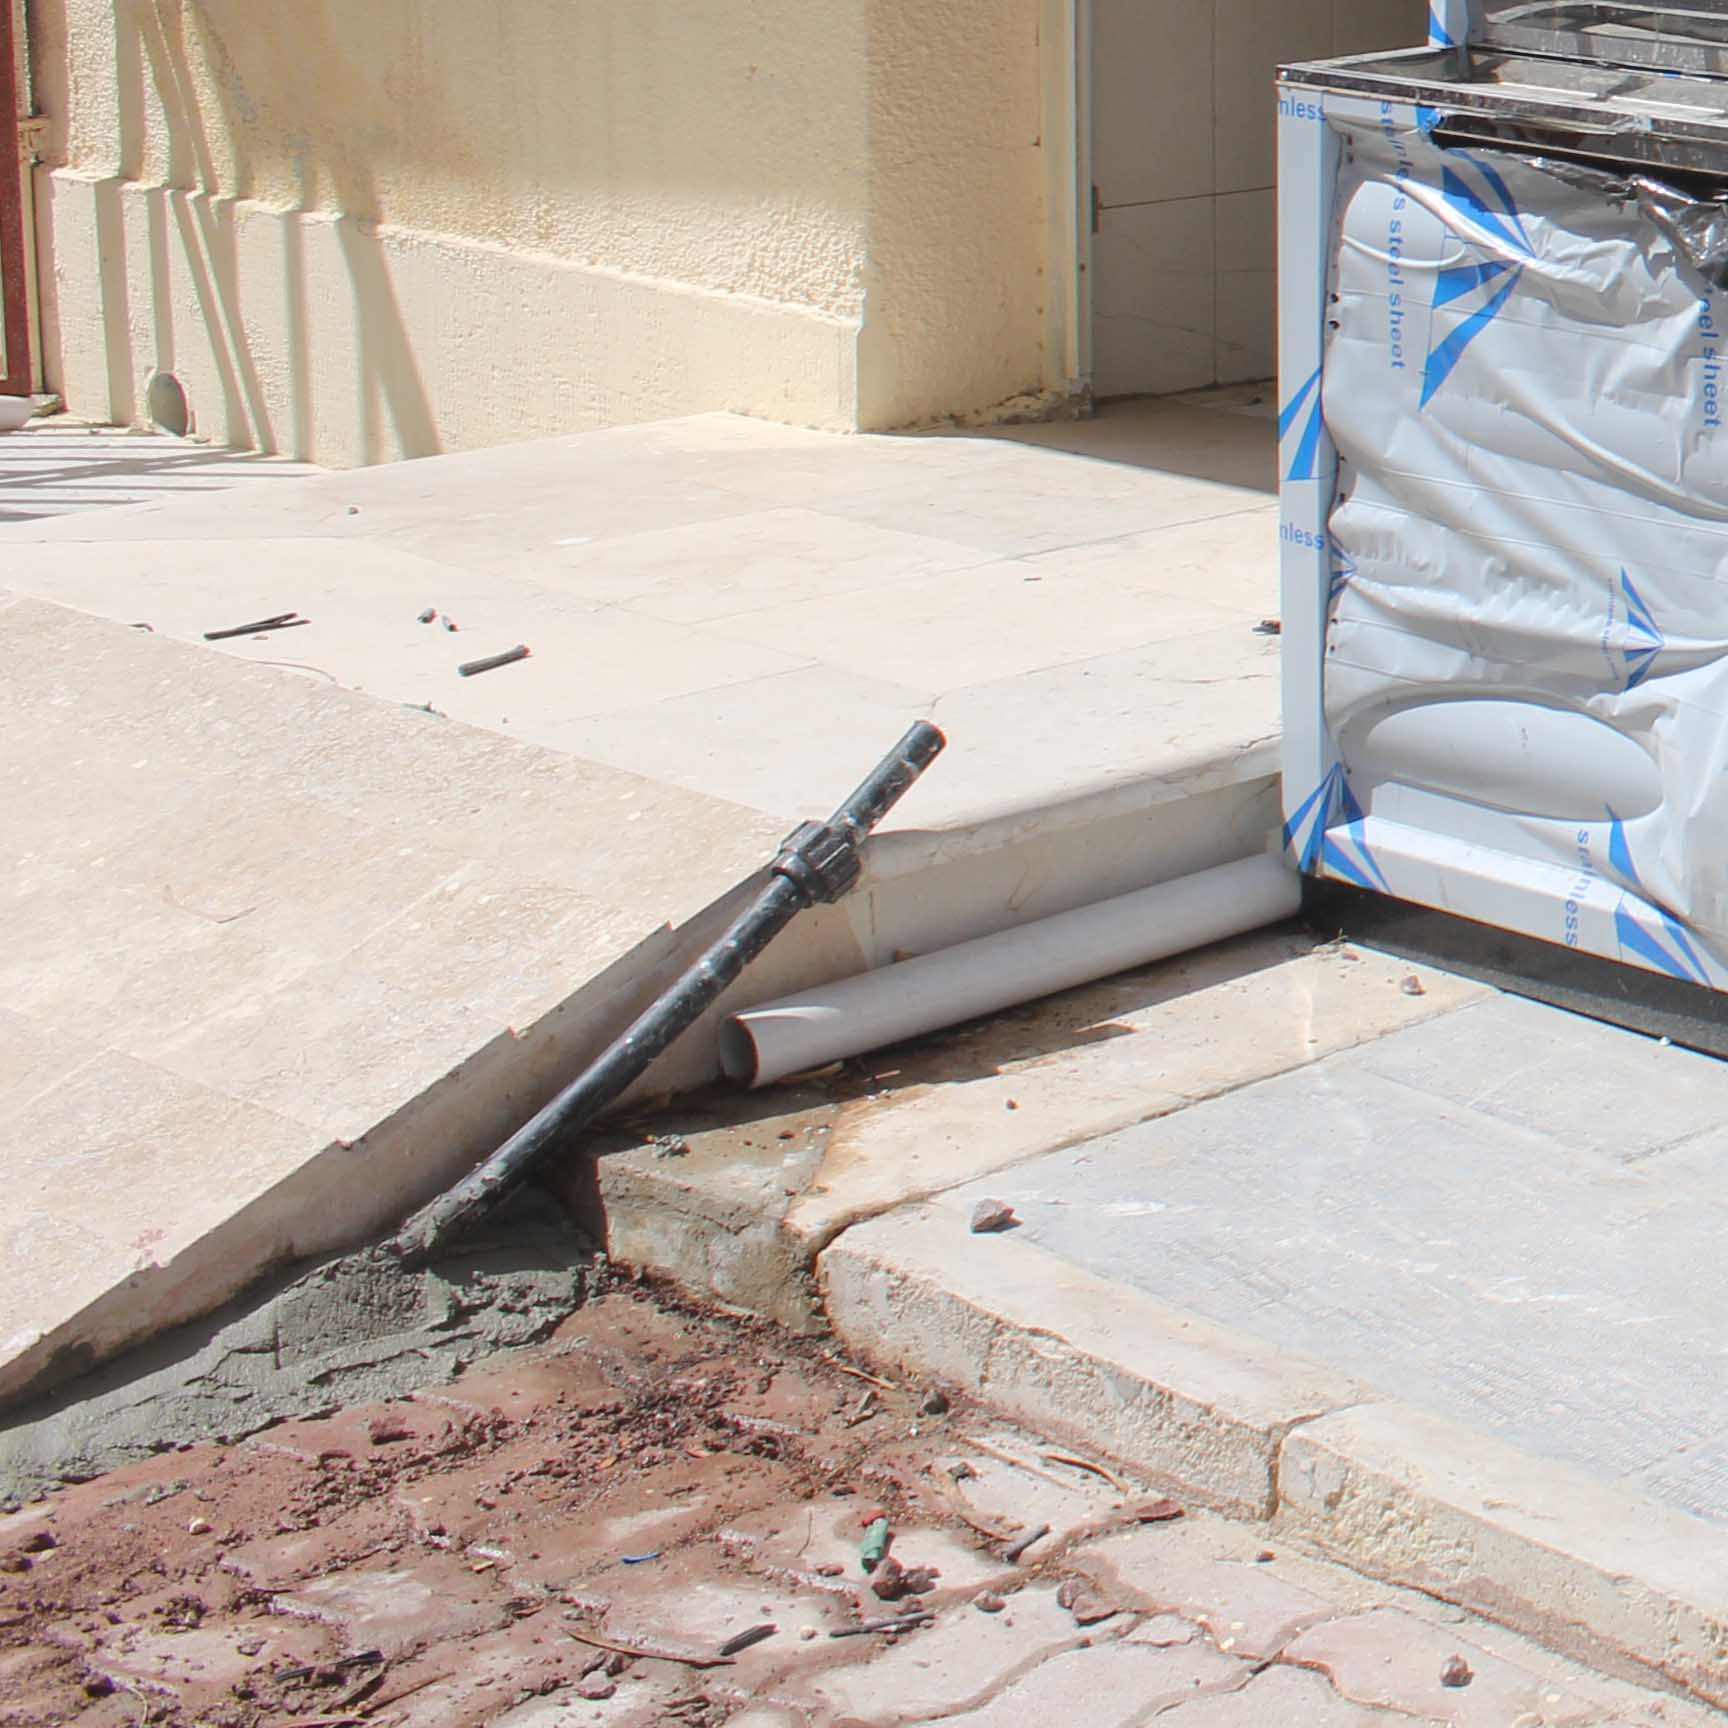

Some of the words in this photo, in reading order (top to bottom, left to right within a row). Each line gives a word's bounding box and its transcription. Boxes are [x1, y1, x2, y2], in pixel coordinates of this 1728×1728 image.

[1387, 219, 1405, 285] steel
[1388, 294, 1406, 369] sheet
[1703, 345, 1722, 427] sheet
